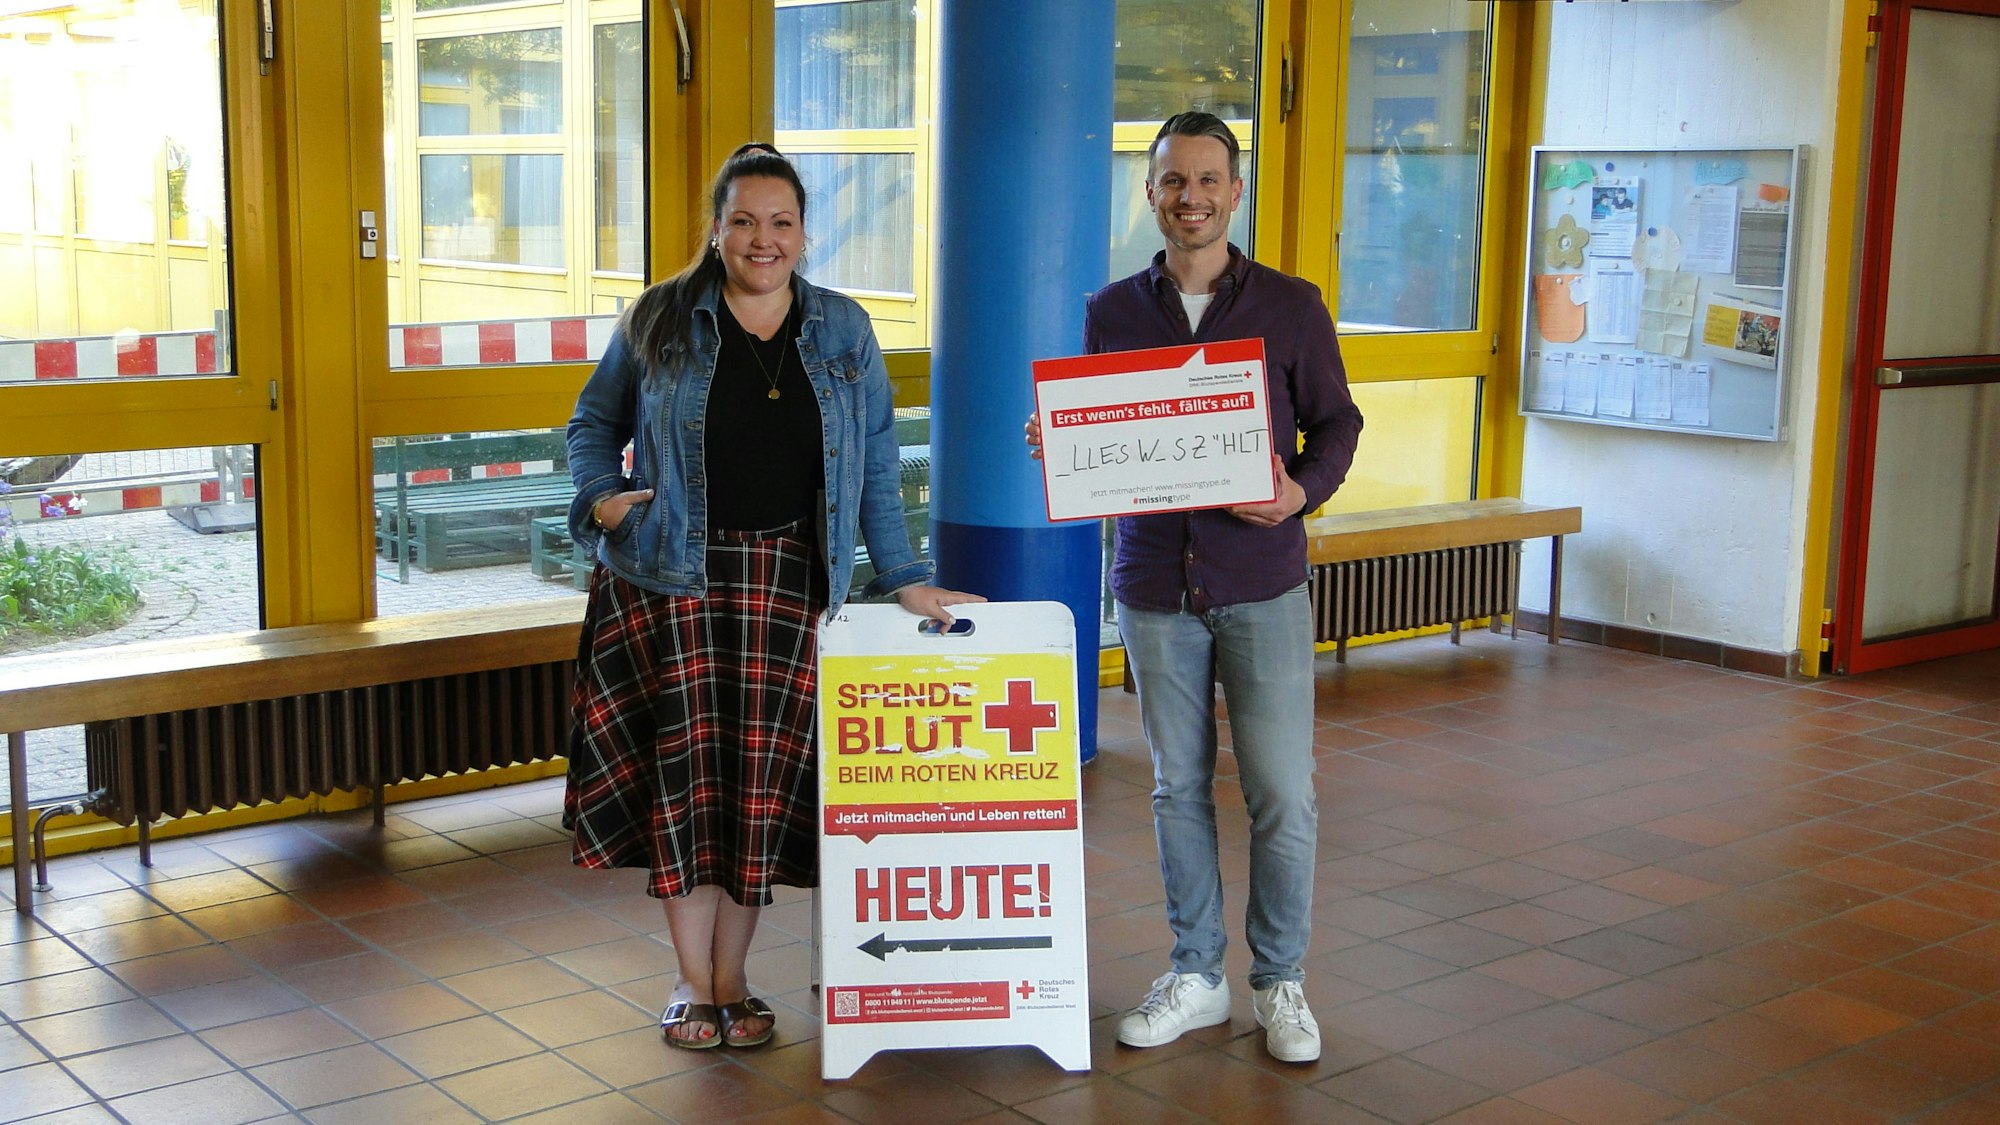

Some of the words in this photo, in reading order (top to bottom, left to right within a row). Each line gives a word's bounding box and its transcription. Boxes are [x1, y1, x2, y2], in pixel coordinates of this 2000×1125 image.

[1055, 411, 1084, 425] Erst
[1085, 407, 1135, 421] wenn's
[1138, 402, 1176, 418] fehlt,
[1179, 398, 1218, 413] fällt's
[1222, 394, 1250, 409] auf!
[1091, 487, 1109, 498] Jetzt
[1109, 484, 1154, 496] mitmachen!
[1155, 477, 1231, 492] www.missingtype.de
[1133, 493, 1191, 505] #missingtype
[837, 682, 973, 709] SPENDE
[838, 715, 973, 755] BLUT
[838, 765, 894, 783] BEIM
[901, 764, 976, 782] ROTEN
[984, 762, 1059, 780] KREUZ
[835, 812, 869, 825] Jetzt
[872, 810, 946, 823] mitmachen
[950, 809, 975, 821] und
[978, 808, 1019, 821] Leben
[1023, 807, 1066, 820] retten!
[855, 863, 1052, 923] HEUTE!
[916, 996, 988, 1004] www.blutspende.jetzt
